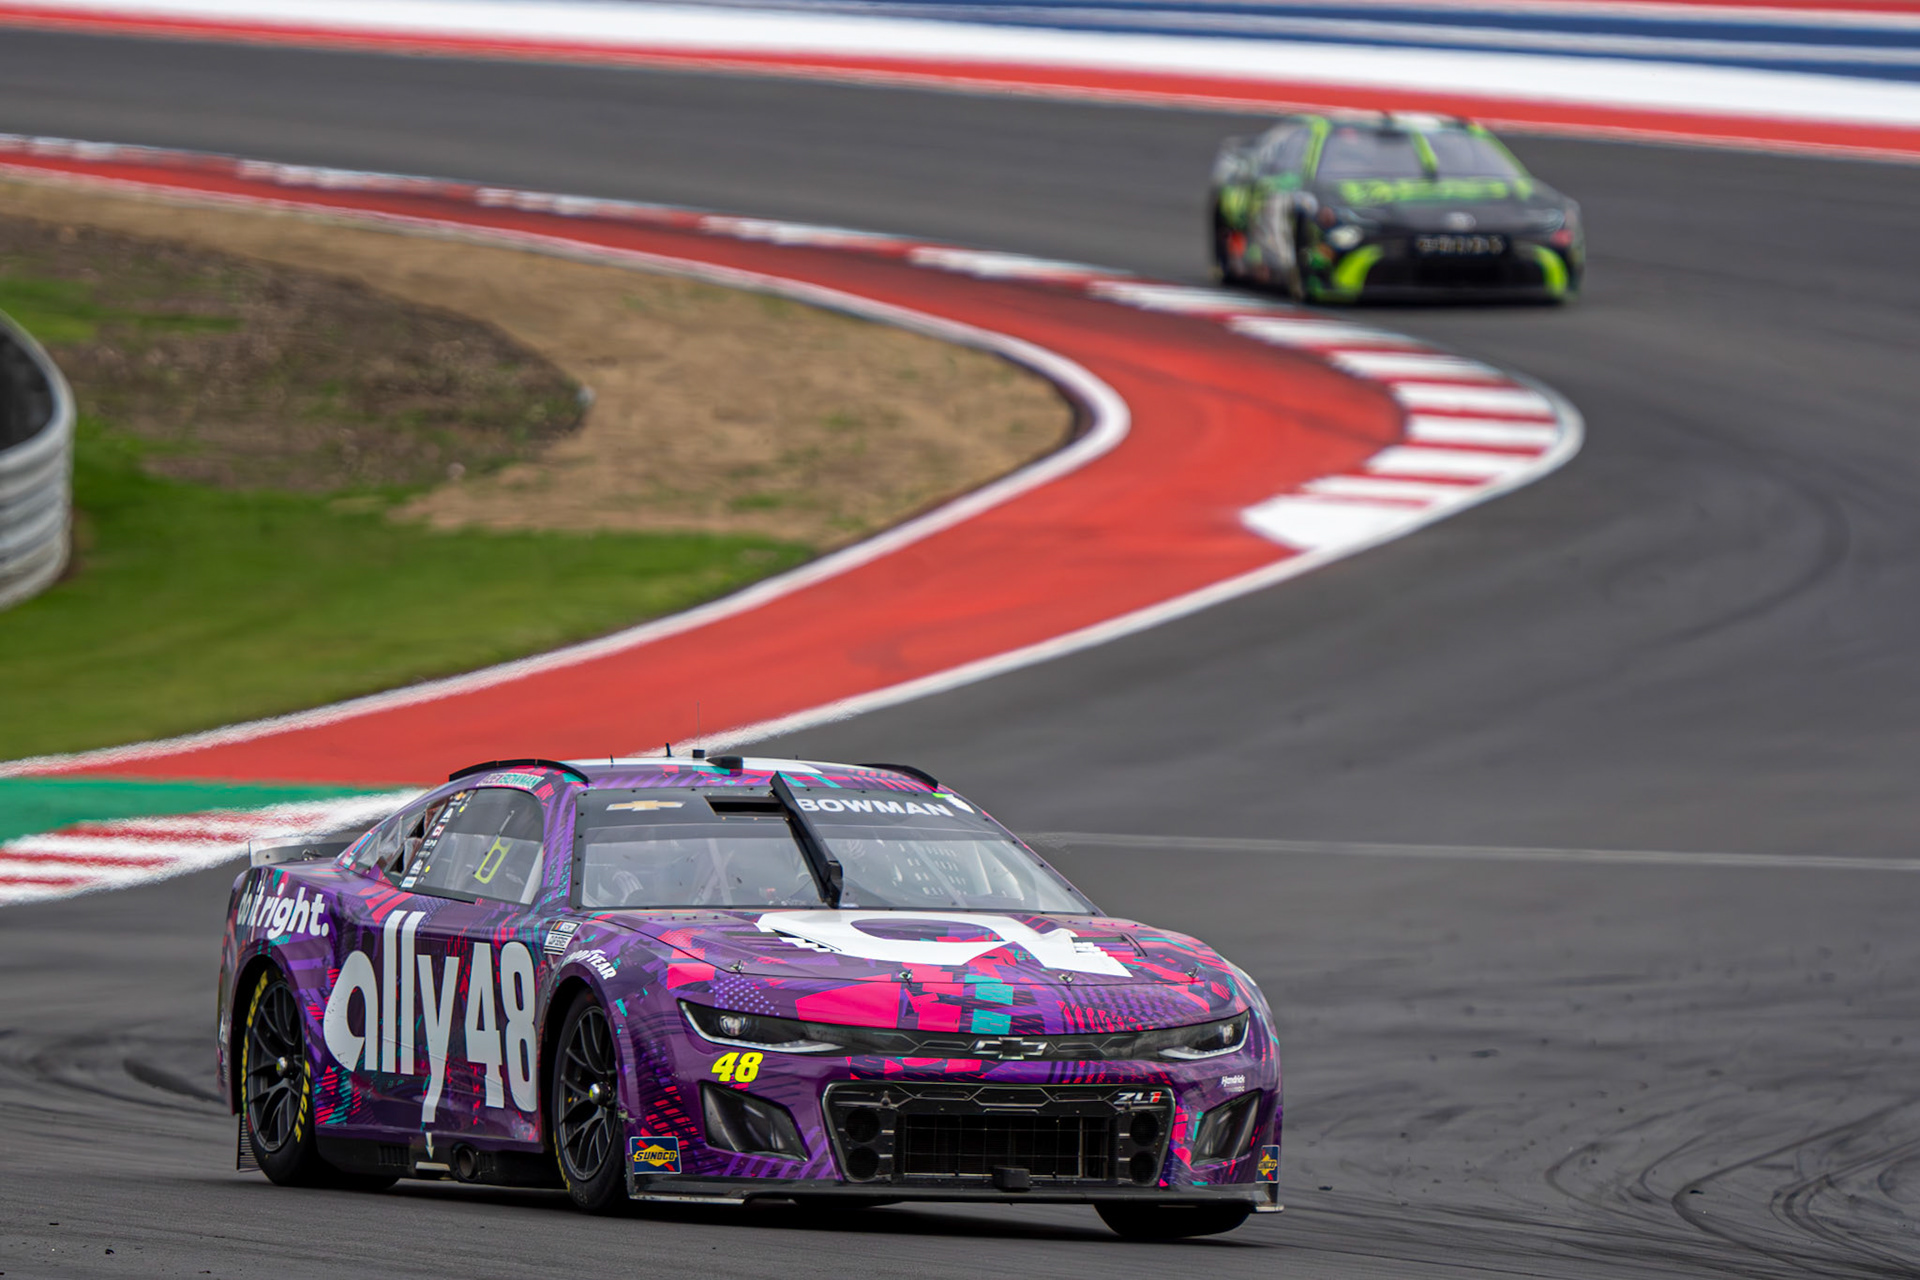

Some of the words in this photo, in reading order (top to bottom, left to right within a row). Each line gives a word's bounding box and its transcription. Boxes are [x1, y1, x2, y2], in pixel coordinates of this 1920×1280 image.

[796, 798, 954, 817] BOWMAN
[256, 882, 329, 940] right.
[711, 1051, 764, 1082] 48
[635, 1151, 675, 1160] SUNOCO
